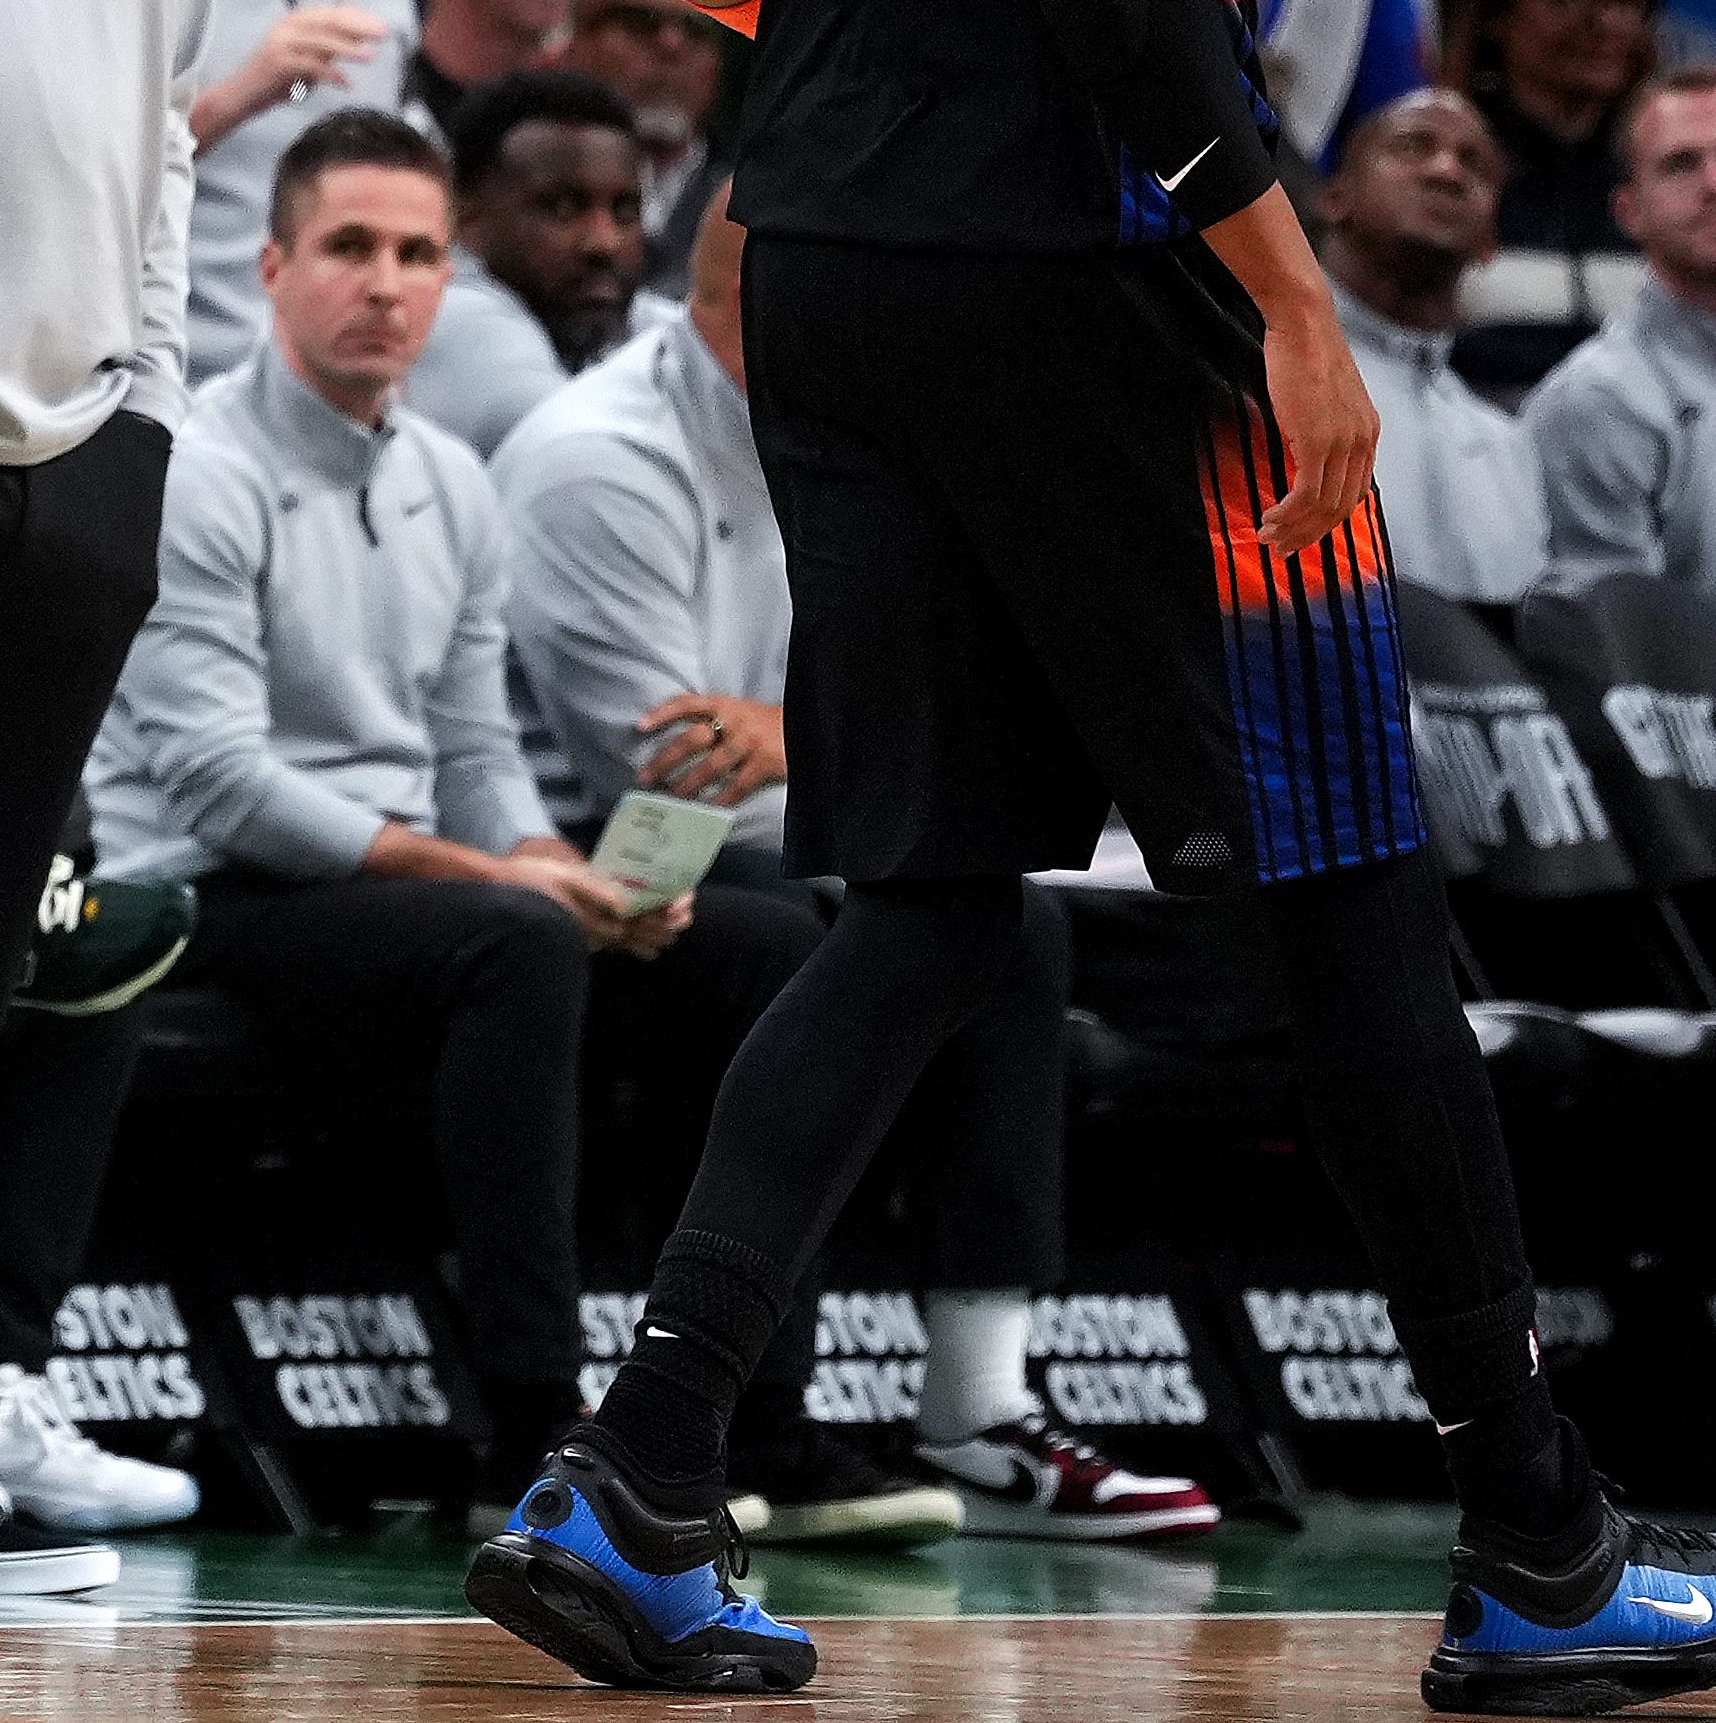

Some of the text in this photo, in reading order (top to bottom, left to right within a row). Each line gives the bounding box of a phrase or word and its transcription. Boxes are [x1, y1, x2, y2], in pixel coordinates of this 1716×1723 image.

[53, 1283, 190, 1351] STON
[232, 1292, 434, 1359] BOSTON
[1243, 1289, 1398, 1354] BOSTO
[46, 1353, 206, 1421] ELTICS
[275, 1361, 451, 1429] CELTICS
[1045, 1361, 1208, 1426] CELTICS
[1281, 1356, 1432, 1422] CELTIC
